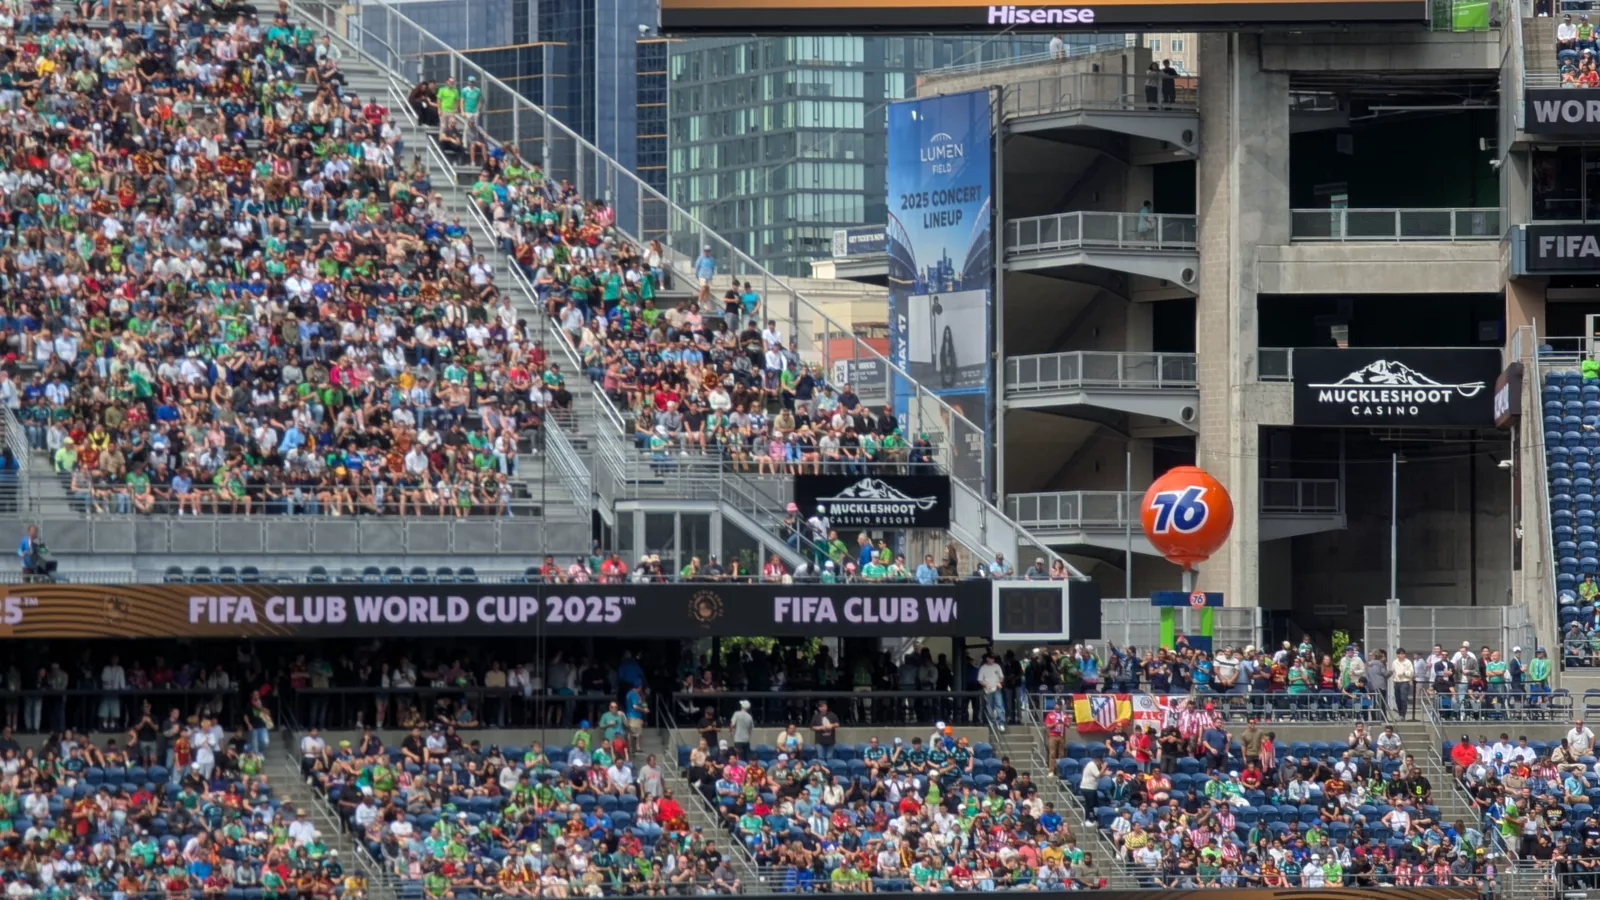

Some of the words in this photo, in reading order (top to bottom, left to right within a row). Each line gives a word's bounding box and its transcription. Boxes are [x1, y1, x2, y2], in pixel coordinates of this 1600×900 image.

[988, 6, 1095, 24] Hisense
[1533, 100, 1600, 123] WOR
[920, 143, 964, 162] LUMEN
[932, 163, 952, 174] FIELD
[901, 192, 930, 210] 2025
[932, 184, 982, 207] CONCERT
[923, 209, 963, 229] LINEUP
[1540, 235, 1600, 258] FIFA
[898, 313, 907, 334] 17
[1318, 389, 1453, 403] MUCKLESHOOT
[1351, 405, 1419, 416] CASINO
[829, 503, 916, 516] MUCKLESHOOT
[1150, 485, 1209, 534] 76
[829, 516, 870, 525] CASINO
[876, 516, 916, 525] RESORT
[189, 597, 258, 623] FIFA
[265, 596, 347, 623] CLUB
[354, 596, 469, 623] WORLD
[476, 596, 538, 623] CUP
[774, 597, 838, 623] FIFA
[844, 596, 919, 623] CLUB
[925, 597, 957, 623] W
[1192, 596, 1204, 604] 76
